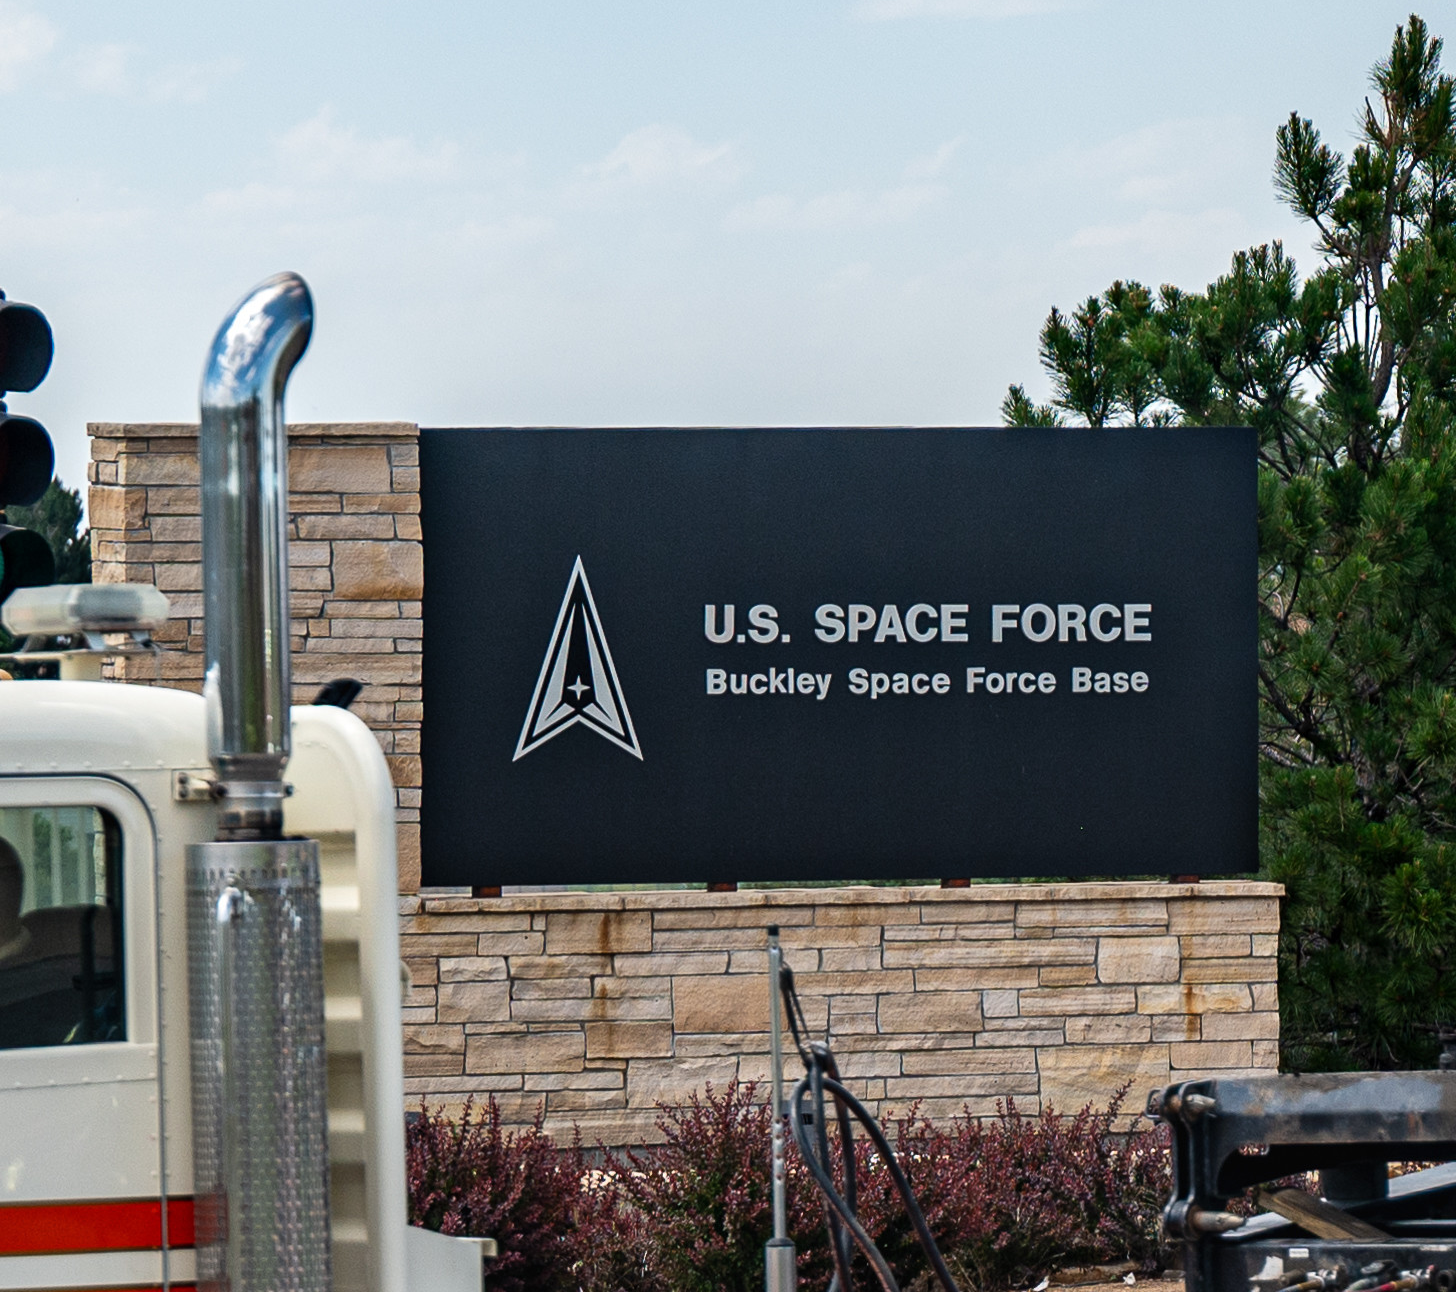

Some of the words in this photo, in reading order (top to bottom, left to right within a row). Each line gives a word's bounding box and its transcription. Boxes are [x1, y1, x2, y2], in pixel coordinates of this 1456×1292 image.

[704, 604, 791, 644] U.S.
[814, 603, 969, 643] SPACE
[992, 603, 1152, 643] FORCE
[706, 667, 832, 701] Buckley
[848, 667, 951, 700] Space
[966, 666, 1057, 694] Force
[1072, 667, 1150, 693] Base
